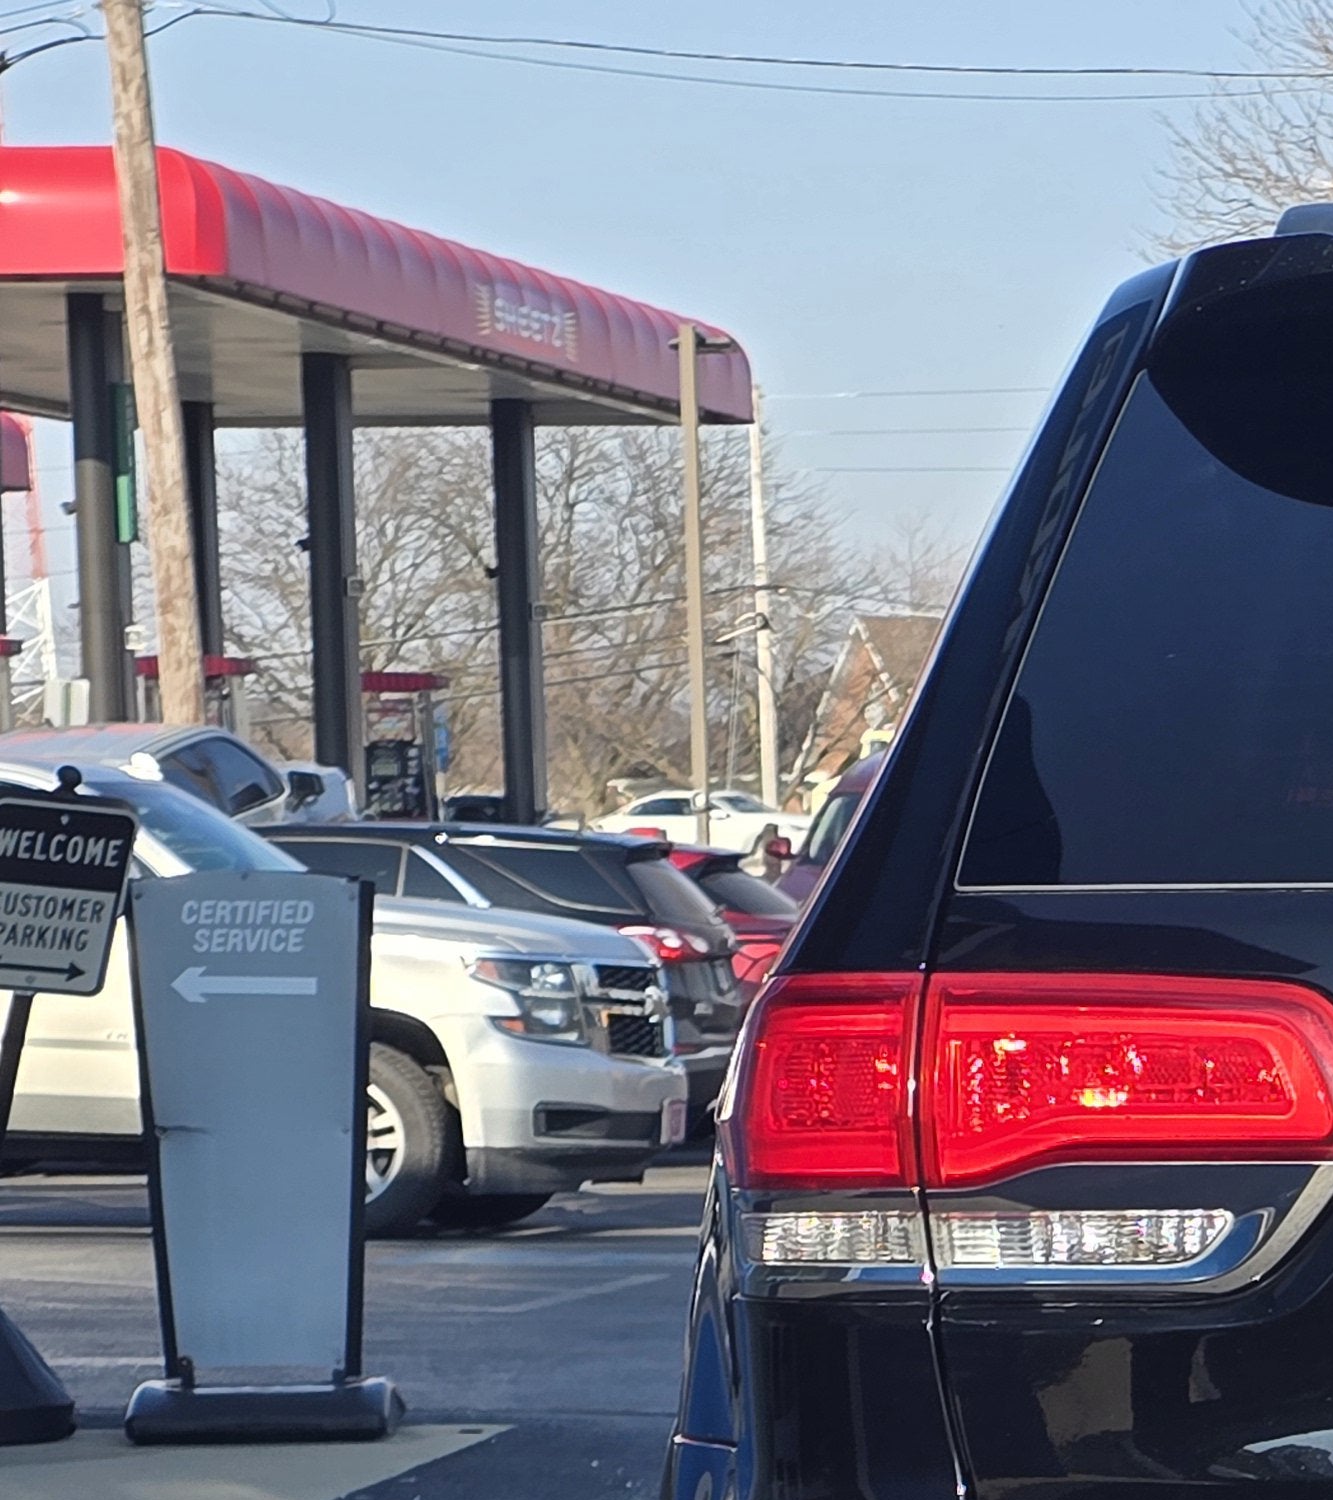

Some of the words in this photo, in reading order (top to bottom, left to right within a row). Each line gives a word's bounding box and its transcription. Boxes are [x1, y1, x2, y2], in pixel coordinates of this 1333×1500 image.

[0, 828, 124, 867] WELCOME
[0, 890, 106, 923] USTOMER
[181, 899, 315, 925] CERTIFIED
[192, 928, 306, 953] SERVICE
